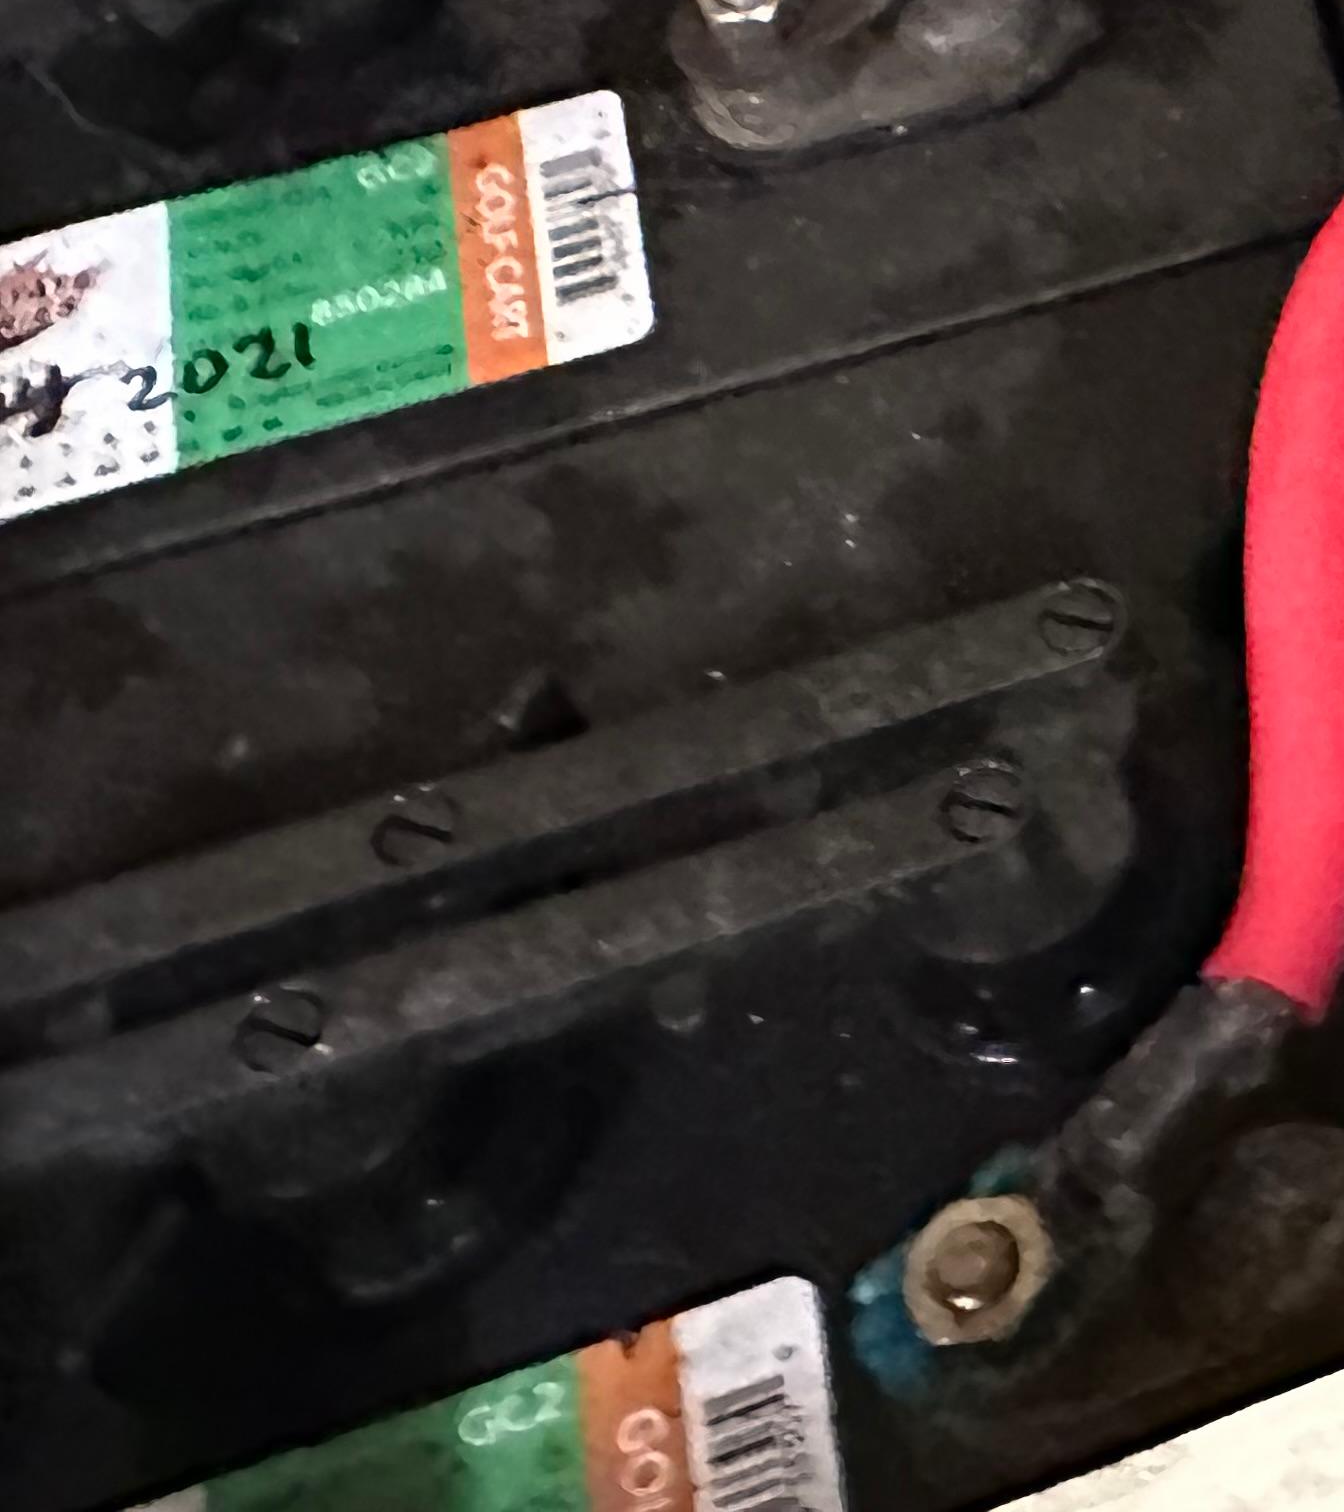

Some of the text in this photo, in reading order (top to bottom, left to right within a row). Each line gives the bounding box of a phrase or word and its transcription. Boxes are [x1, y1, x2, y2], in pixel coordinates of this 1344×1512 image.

[475, 163, 529, 341] GOLF CART
[120, 321, 317, 411] 2021
[458, 1381, 566, 1446] GC2
